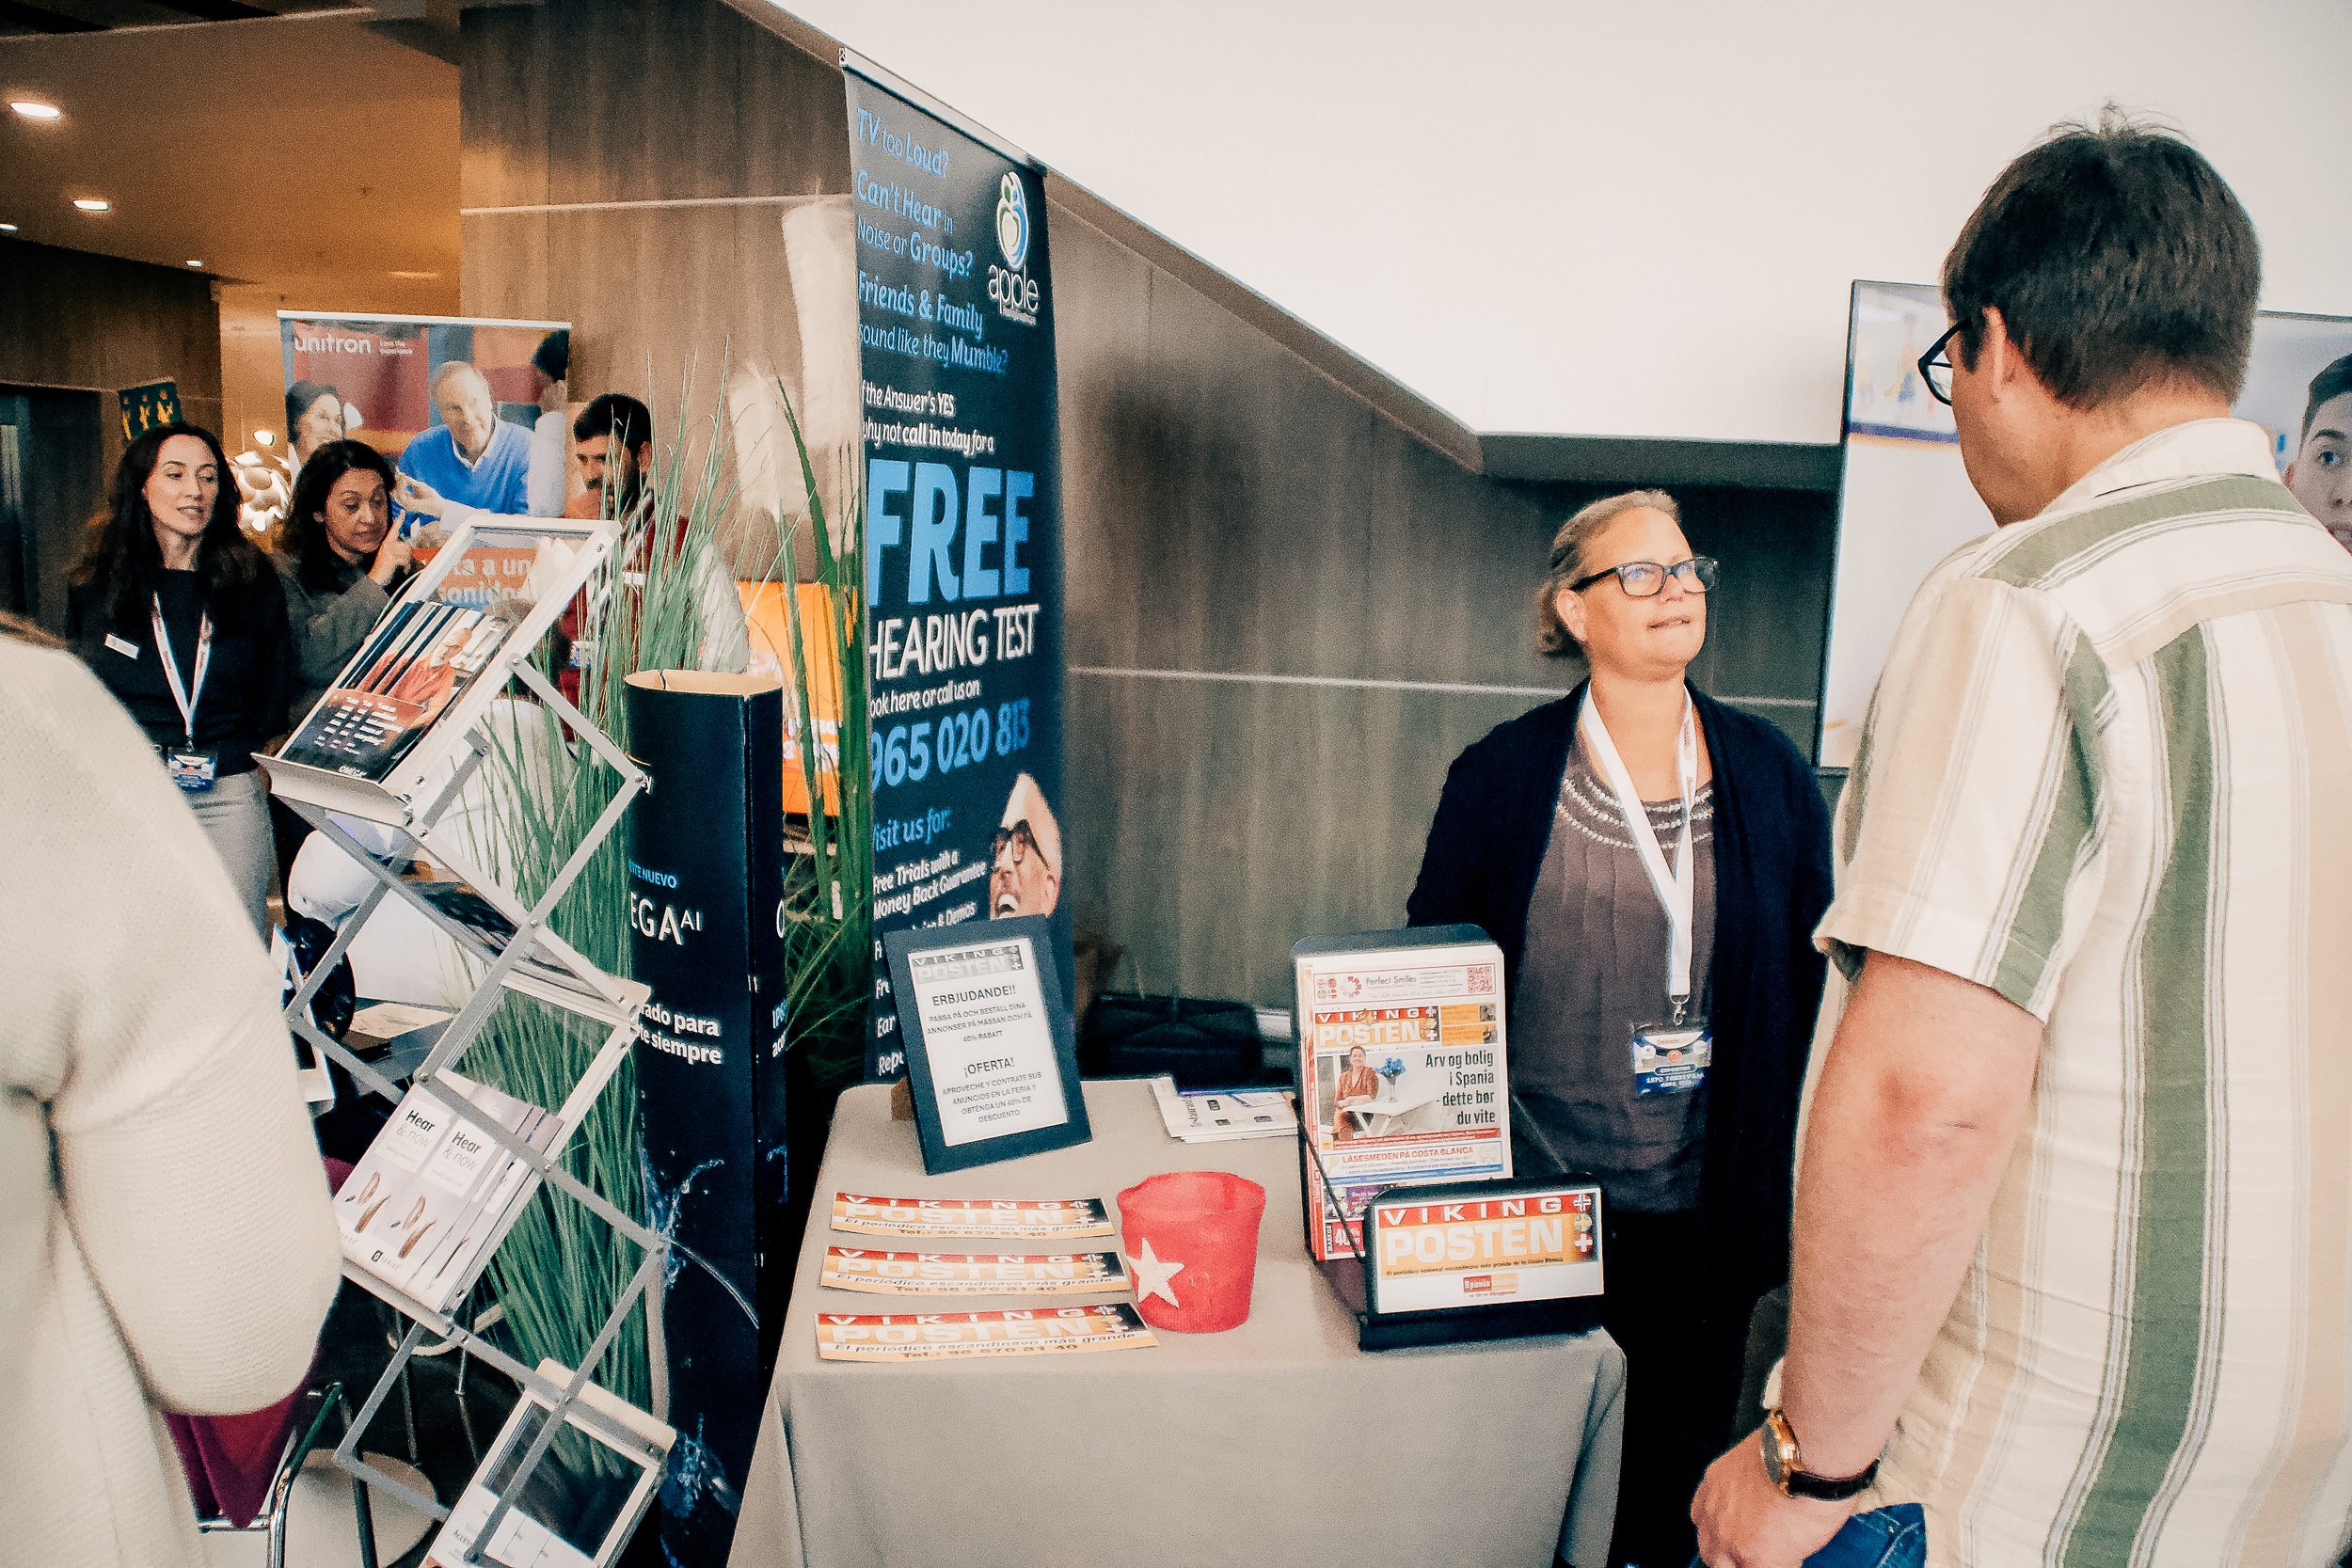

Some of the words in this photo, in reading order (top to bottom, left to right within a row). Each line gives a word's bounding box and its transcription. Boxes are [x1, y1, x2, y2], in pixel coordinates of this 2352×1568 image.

[857, 107, 882, 145] TV
[882, 127, 904, 157] too
[905, 133, 950, 178] Loud?
[856, 169, 900, 214] Can't
[902, 191, 943, 230] Hear
[944, 210, 954, 234] in
[857, 215, 891, 251] Noise
[893, 235, 908, 256] or
[909, 231, 974, 280] Groups?
[988, 263, 1040, 314] apple
[857, 271, 915, 318] Friends
[918, 289, 933, 321] &
[936, 293, 984, 341] Family
[294, 334, 372, 354] unitron
[898, 328, 919, 356] like
[923, 334, 949, 368] they
[951, 336, 1009, 374] Mumble?
[862, 381, 868, 404] f
[867, 383, 882, 406] the
[884, 387, 936, 414] Answer's
[938, 393, 955, 417] YES
[882, 422, 901, 442] not
[902, 423, 927, 445] call
[930, 427, 941, 446] in
[942, 428, 971, 456] today
[970, 432, 987, 455] for
[987, 436, 994, 451] a
[867, 458, 1035, 608] FREE
[993, 603, 1041, 660] TEST
[870, 691, 889, 718] ook
[890, 689, 920, 713] here
[922, 688, 937, 708] or
[937, 680, 954, 705] call
[953, 683, 964, 700] us
[965, 680, 980, 698] on
[937, 707, 991, 774] 020
[873, 818, 899, 852] isit
[903, 818, 924, 843] us
[896, 860, 930, 885] Trials
[930, 850, 950, 875] with
[873, 893, 911, 921] Money
[913, 879, 939, 906] Back
[940, 861, 987, 895] Guarantee
[946, 901, 977, 926] Demos
[914, 947, 1005, 967] VIKING
[917, 956, 1009, 981] POSTEN
[1365, 976, 1391, 986] Perfect
[1393, 974, 1417, 984] Smiles
[932, 984, 1017, 1006] ERBJUDANDE!!
[930, 1013, 952, 1022] PASSA
[963, 1009, 979, 1018] OCH
[1009, 1002, 1025, 1012] DINA
[674, 1013, 720, 1037] para
[927, 1022, 967, 1035] ANNONSER
[1008, 1013, 1023, 1023] OCH
[977, 1030, 1003, 1040] RABATT
[1319, 1021, 1422, 1047] POSTEN
[651, 1030, 722, 1065] siempre
[963, 1056, 1015, 1079] ¡OFERTA!
[1425, 1053, 1448, 1069] Arv
[1448, 1054, 1462, 1069] og
[1465, 1050, 1494, 1069] bolig
[942, 1083, 985, 1096] APROVECHE
[991, 1074, 1027, 1088] CONTRATE
[1028, 1071, 1042, 1080] SUS
[1449, 1073, 1453, 1085] i
[1455, 1069, 1494, 1088] Spania
[952, 1092, 991, 1105] ANUNCIOS
[991, 1090, 1001, 1099] EN
[1002, 1088, 1010, 1097] LA
[1010, 1085, 1031, 1095] FERIA
[995, 1101, 1007, 1109] UN
[1022, 1096, 1032, 1104] DE
[1442, 1093, 1474, 1107] dette
[1475, 1091, 1494, 1105] bør
[405, 1109, 436, 1132] Hear
[978, 1109, 1021, 1123] DESCUENTO
[1457, 1111, 1471, 1126] du
[1474, 1109, 1496, 1124] vite
[452, 1132, 483, 1154] Hear
[1411, 1149, 1439, 1158] COSTA
[1440, 1146, 1474, 1156] BLANCA
[845, 1194, 1062, 1210] VIKING
[1383, 1197, 1563, 1227] VIKING
[845, 1203, 1064, 1225] POSTEN
[1386, 1217, 1564, 1267] POSTEN
[837, 1248, 1073, 1264] VIKING
[838, 1258, 1075, 1280] POSTEN
[828, 1308, 1086, 1325] VIKING
[831, 1316, 1094, 1344] POSTEN
[1082, 1332, 1136, 1343] grande
